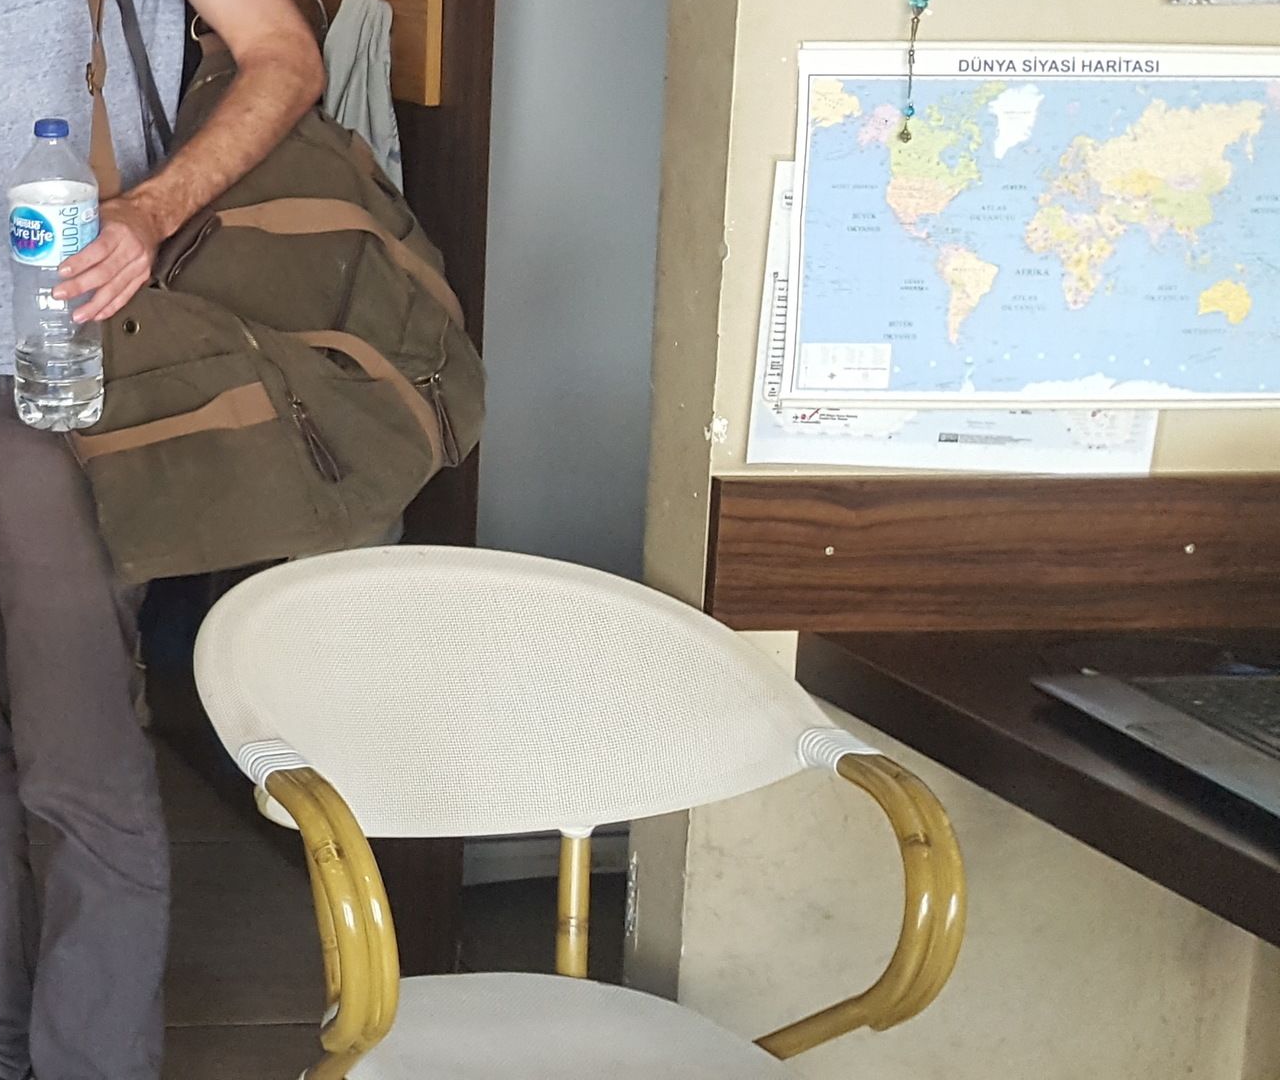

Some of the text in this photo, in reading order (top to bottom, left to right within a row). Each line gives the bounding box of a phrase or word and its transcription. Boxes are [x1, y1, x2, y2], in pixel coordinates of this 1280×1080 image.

[958, 56, 1160, 74] DÜNYA SİYASİ HARİTASI
[31, 229, 55, 246] Life
